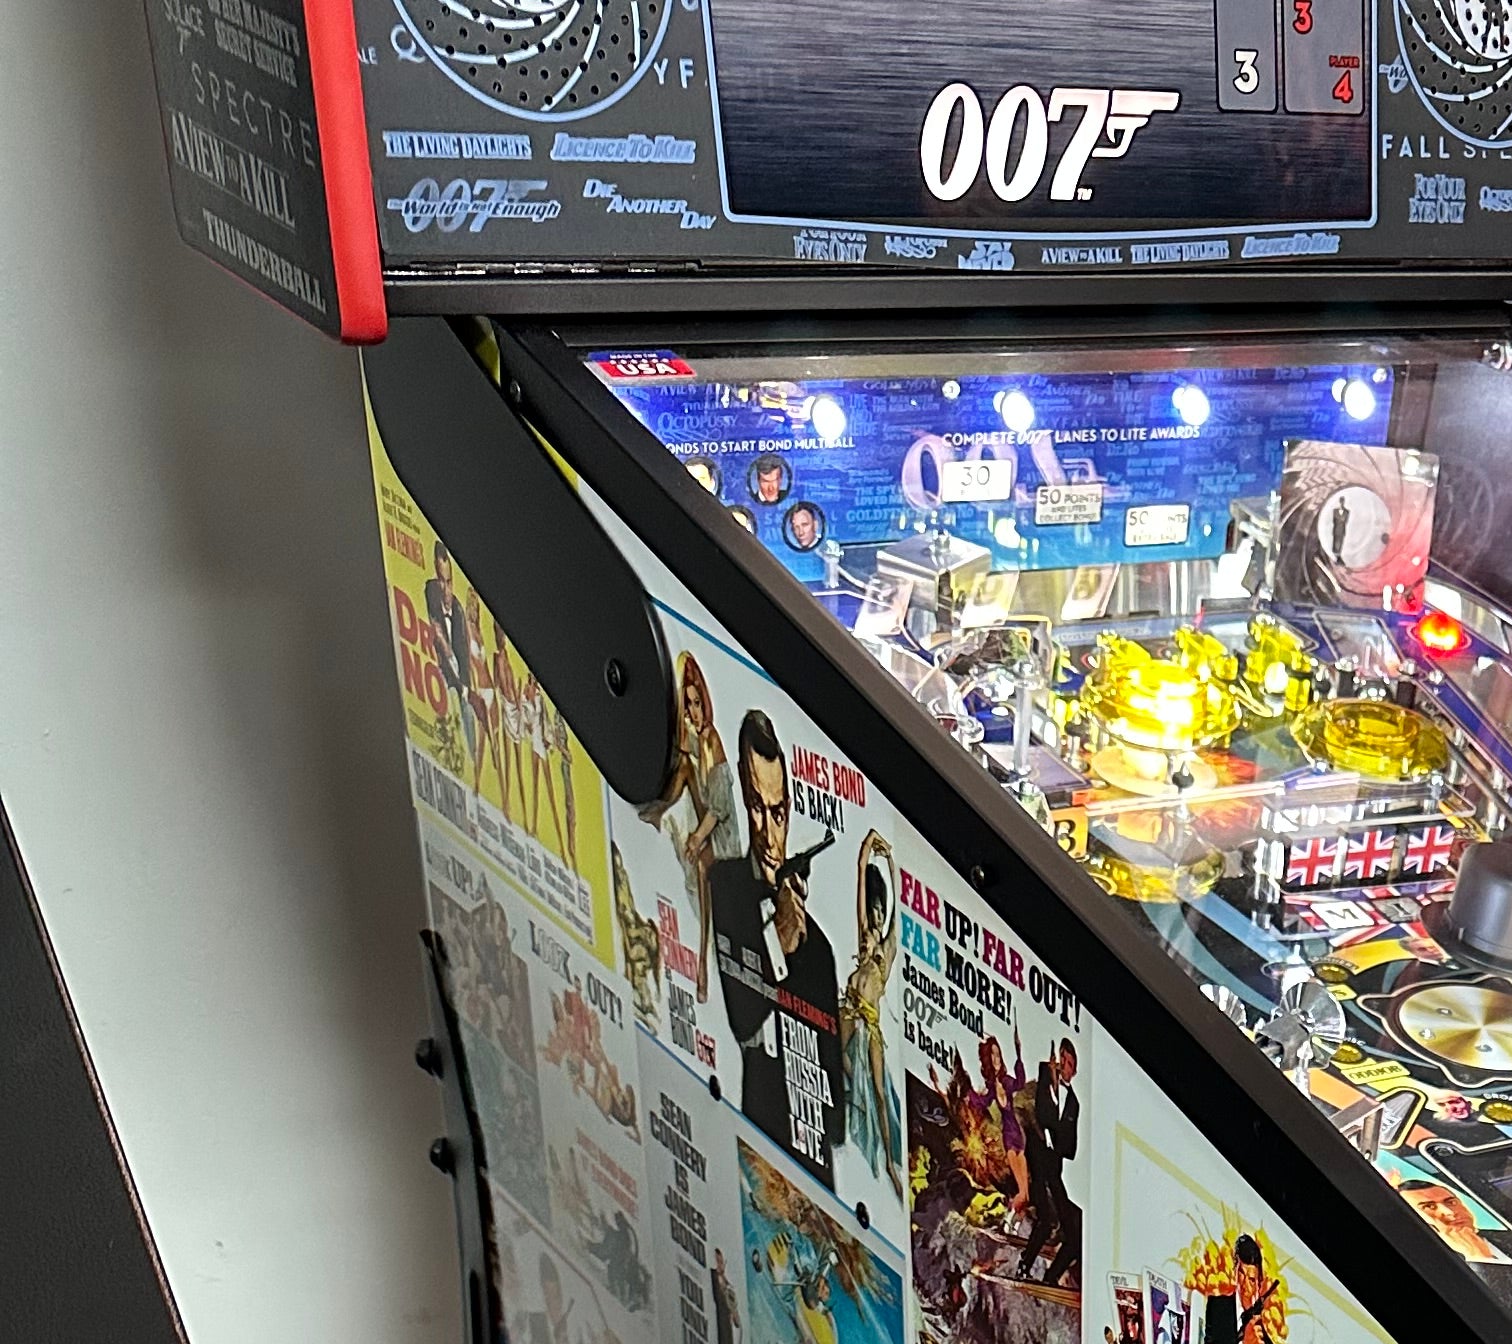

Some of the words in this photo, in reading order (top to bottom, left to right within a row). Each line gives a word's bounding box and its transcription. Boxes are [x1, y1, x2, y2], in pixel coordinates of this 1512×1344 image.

[1233, 49, 1259, 93] 3
[1329, 55, 1359, 68] PLAYER
[1332, 71, 1353, 103] 4
[192, 61, 316, 169] SPECTRE
[921, 82, 1162, 201] 007
[1382, 134, 1450, 159] FALL
[583, 179, 617, 197] DIE
[607, 196, 688, 214] ANOTHER
[681, 211, 717, 230] DAY
[203, 208, 326, 314] THUNDERBALL
[617, 363, 677, 375] USA
[703, 443, 719, 452] TO
[721, 441, 755, 452] START
[759, 440, 791, 451] BOND
[943, 432, 1014, 446] COMPLETE
[1055, 430, 1096, 443] LANES
[1100, 429, 1115, 441] TO
[1120, 428, 1147, 440] LITE
[1150, 425, 1200, 439] AWARDS
[961, 466, 990, 486] 30
[1039, 489, 1061, 505] 50
[400, 643, 448, 716] NO
[791, 744, 830, 793] JAMES
[834, 765, 866, 808] BOND
[793, 780, 805, 815] IS
[807, 792, 845, 834] BACK!
[900, 868, 941, 930] FAR
[944, 901, 980, 957] UP!
[981, 927, 1025, 991] FAR
[1028, 965, 1081, 1034] OUT!
[902, 911, 941, 973] FAR
[944, 944, 1012, 1025] MORE!
[902, 954, 945, 1008] James
[949, 994, 985, 1038] Bond
[903, 987, 943, 1028] 007
[779, 1011, 820, 1066] FROM
[904, 1017, 915, 1045] is
[784, 1047, 834, 1107] RUSSIA
[786, 1082, 825, 1134] WITH
[789, 1114, 825, 1166] LOVE
